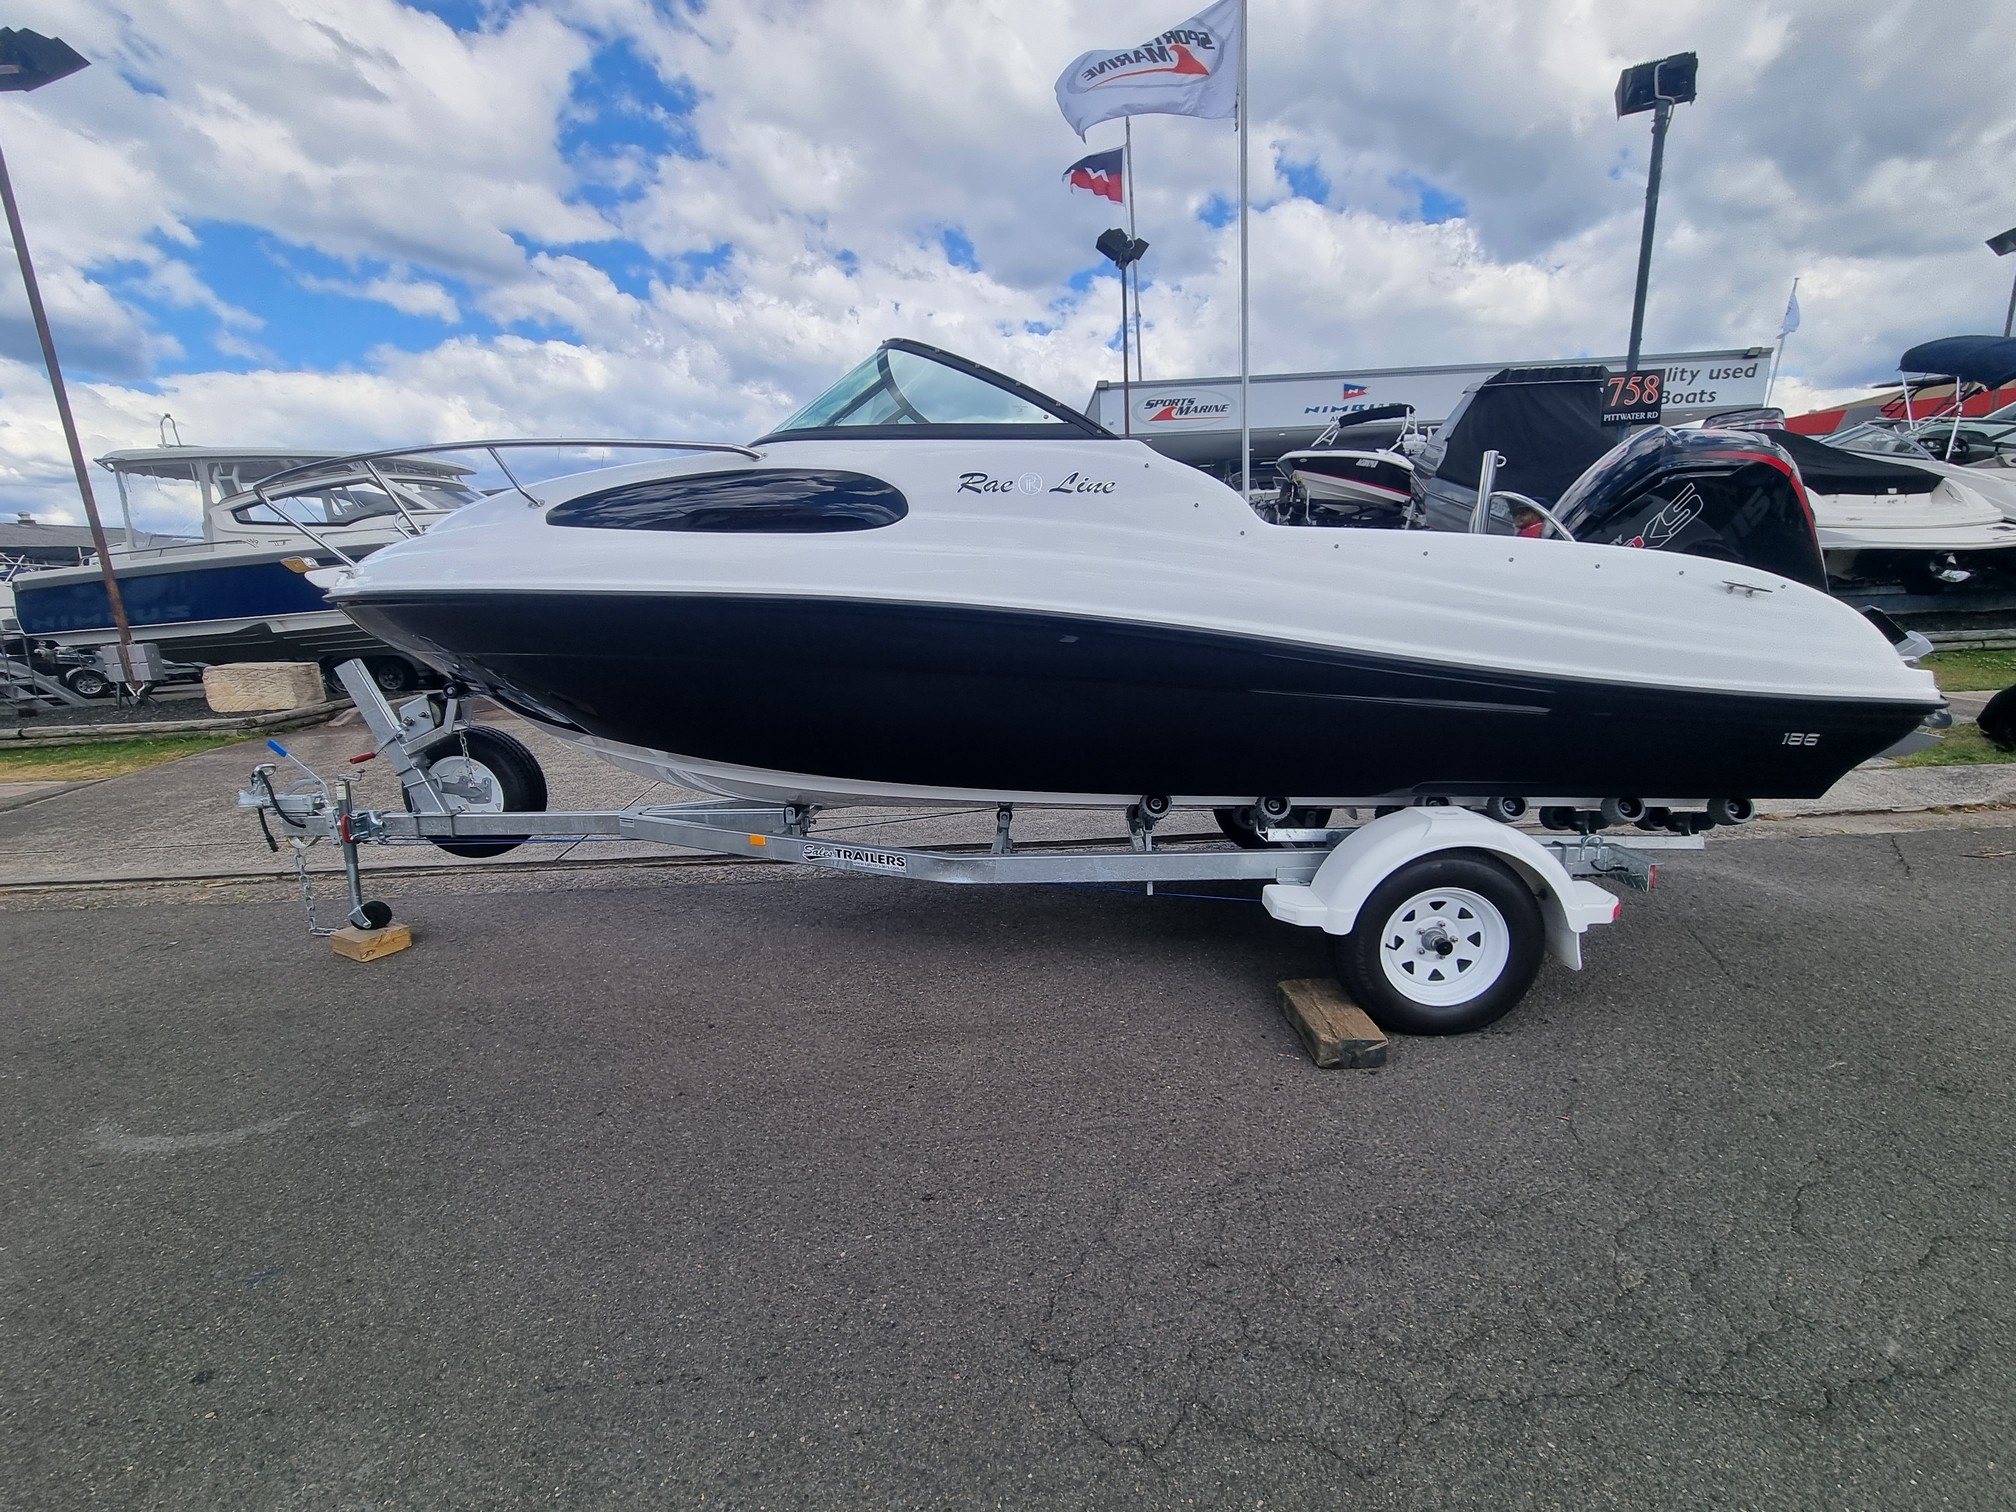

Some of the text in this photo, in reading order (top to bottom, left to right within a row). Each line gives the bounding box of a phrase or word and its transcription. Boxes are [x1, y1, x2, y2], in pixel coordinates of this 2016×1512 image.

[1665, 363, 1758, 386] lity used
[1607, 374, 1660, 407] 758
[1661, 389, 1717, 405] Boats
[1143, 397, 1197, 410] SPORTS
[1175, 404, 1231, 416] MARINE
[1603, 411, 1659, 422] PITTWATER RD
[957, 471, 1014, 494] Rae
[1048, 471, 1117, 494] Line
[1781, 732, 1820, 746] 186
[834, 848, 906, 867] TRAILERS
